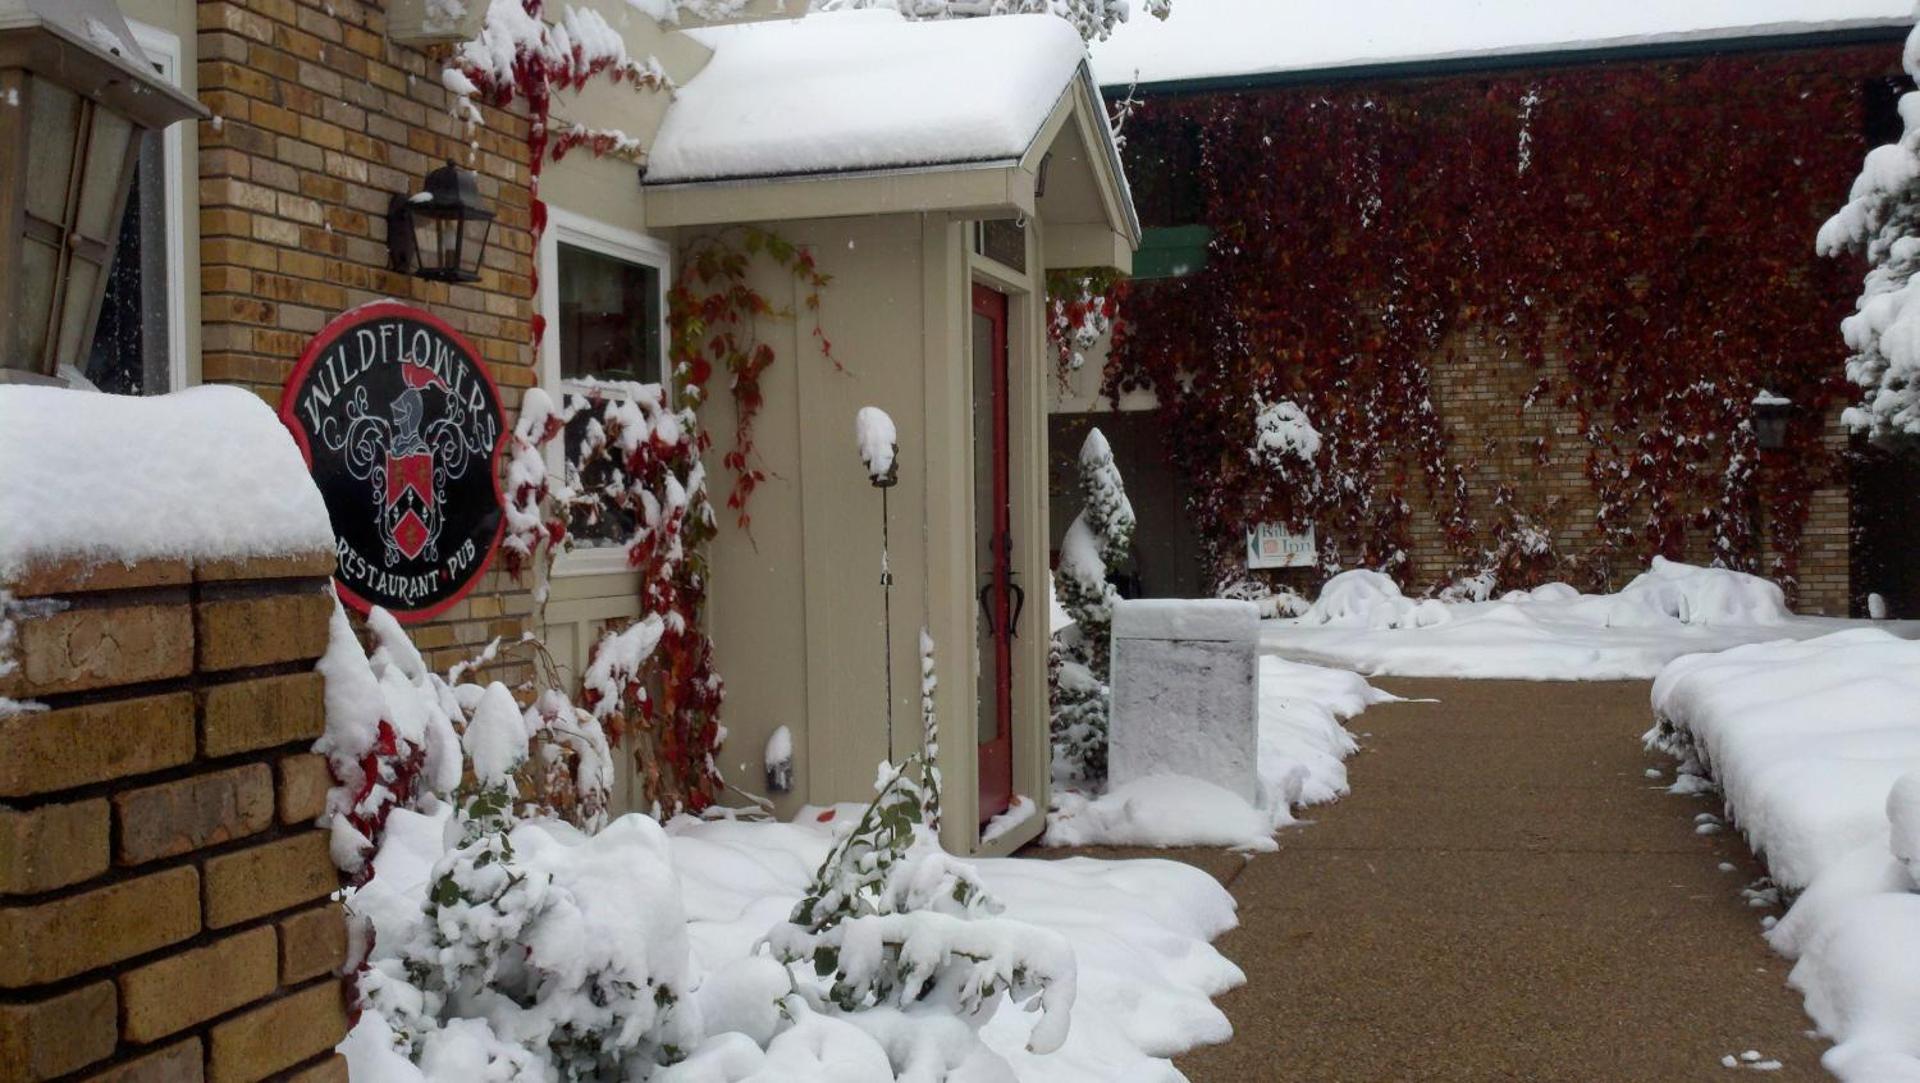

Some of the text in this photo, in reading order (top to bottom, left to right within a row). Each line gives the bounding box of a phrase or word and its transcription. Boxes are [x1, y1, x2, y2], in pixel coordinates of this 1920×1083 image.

[304, 323, 496, 459] WILDFLOWERS
[335, 536, 476, 605] RESTAURANT PUB
